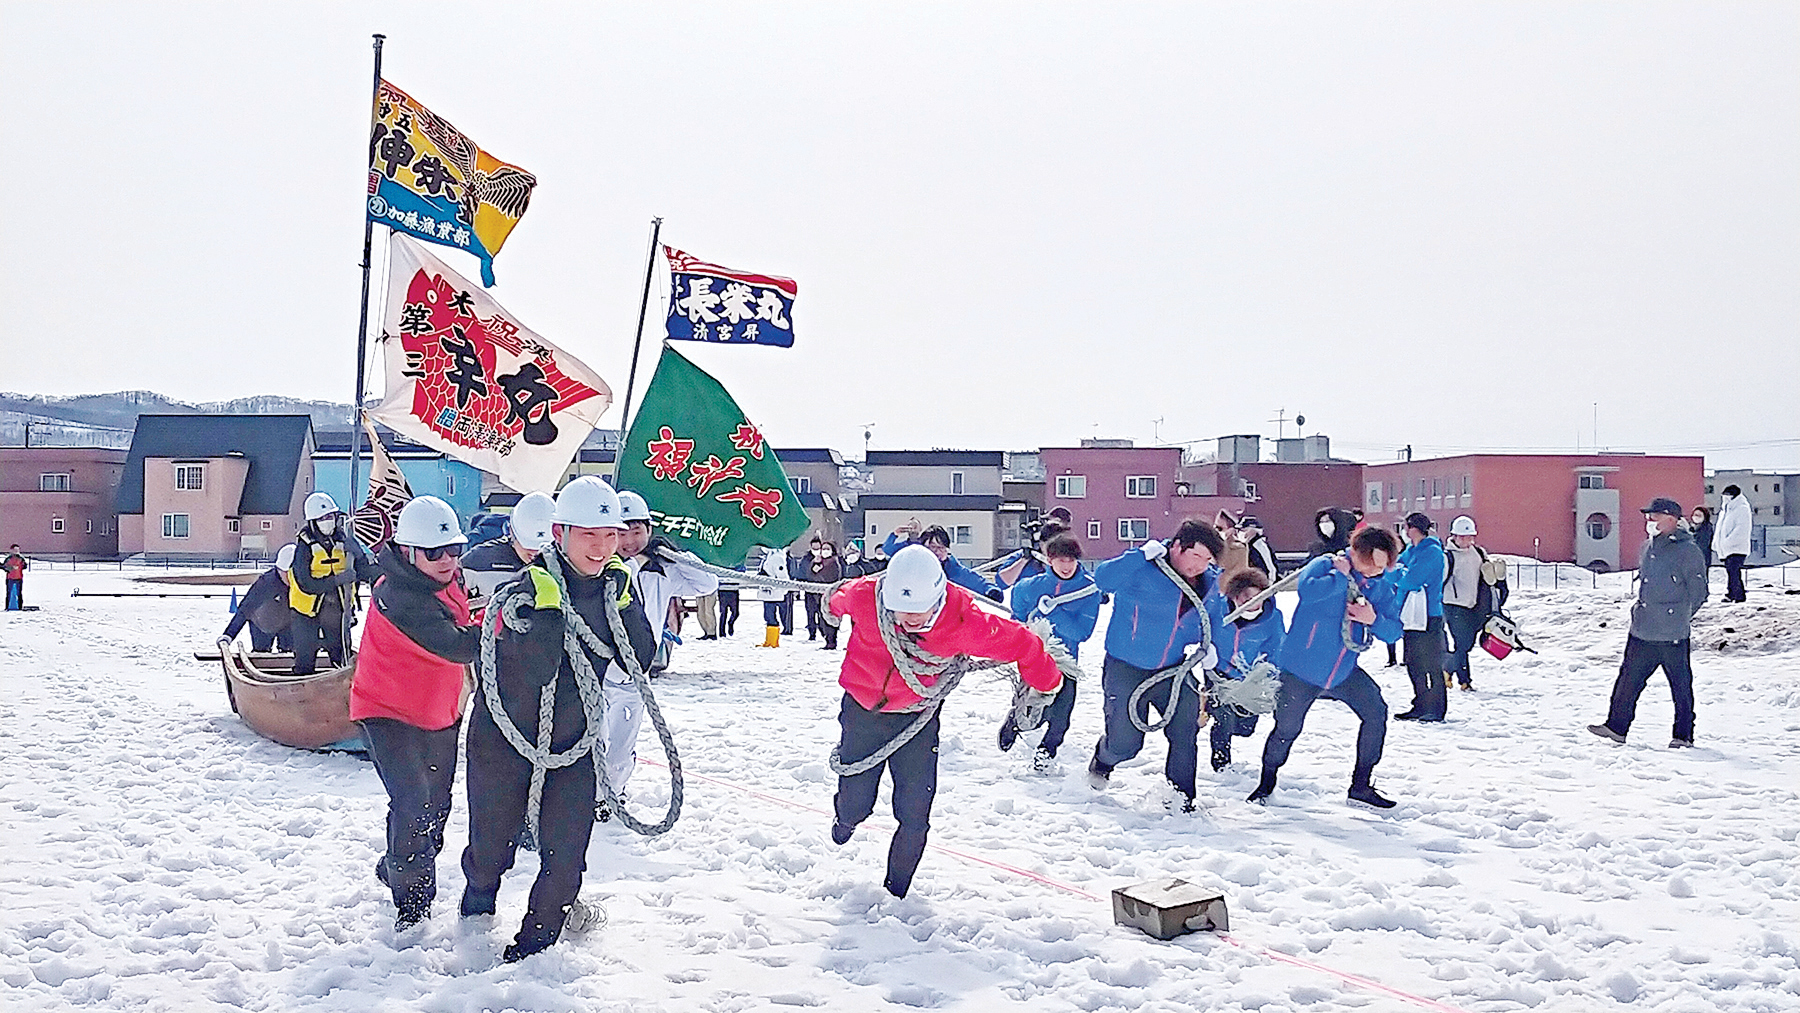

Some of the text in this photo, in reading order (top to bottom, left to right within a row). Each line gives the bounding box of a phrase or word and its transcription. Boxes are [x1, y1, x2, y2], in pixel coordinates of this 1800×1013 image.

[680, 277, 790, 330] 長栄丸
[399, 304, 434, 379] 第三
